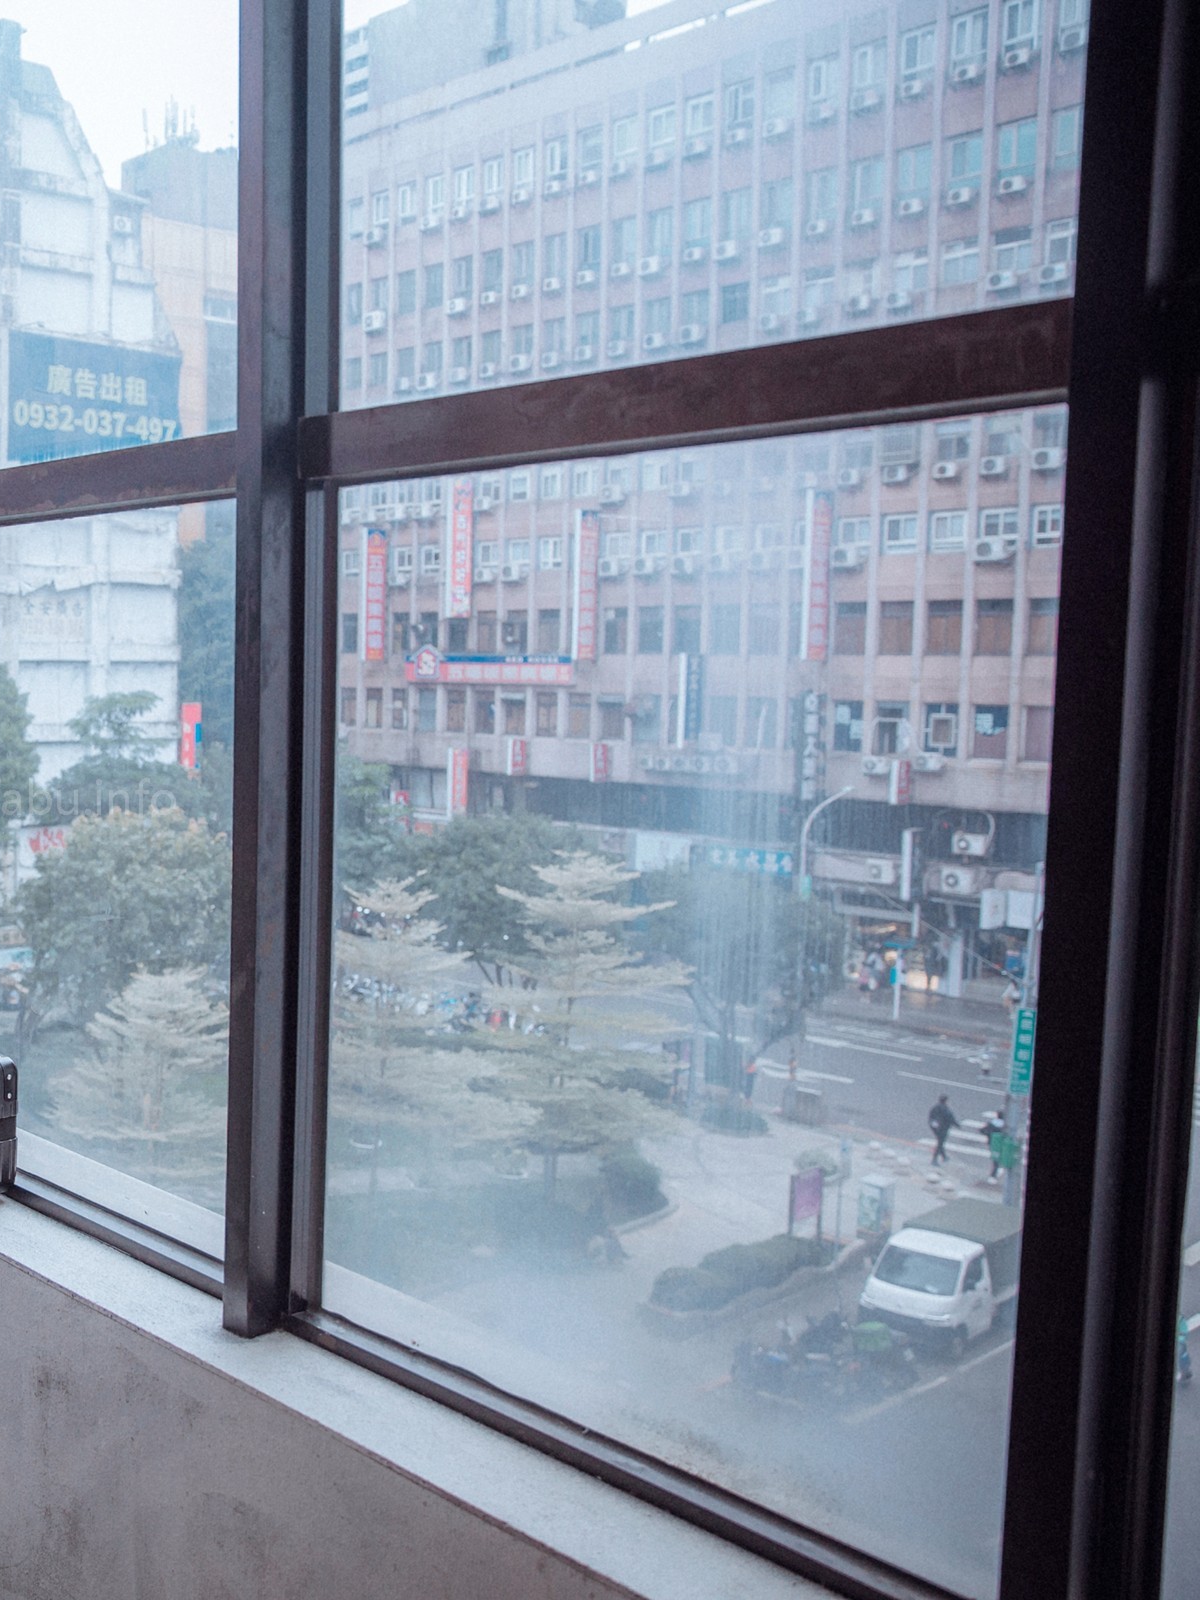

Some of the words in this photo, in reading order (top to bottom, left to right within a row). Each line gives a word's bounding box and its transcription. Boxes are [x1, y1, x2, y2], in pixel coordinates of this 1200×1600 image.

[47, 364, 148, 407] 廣告出租
[13, 399, 177, 443] 0932-037-497
